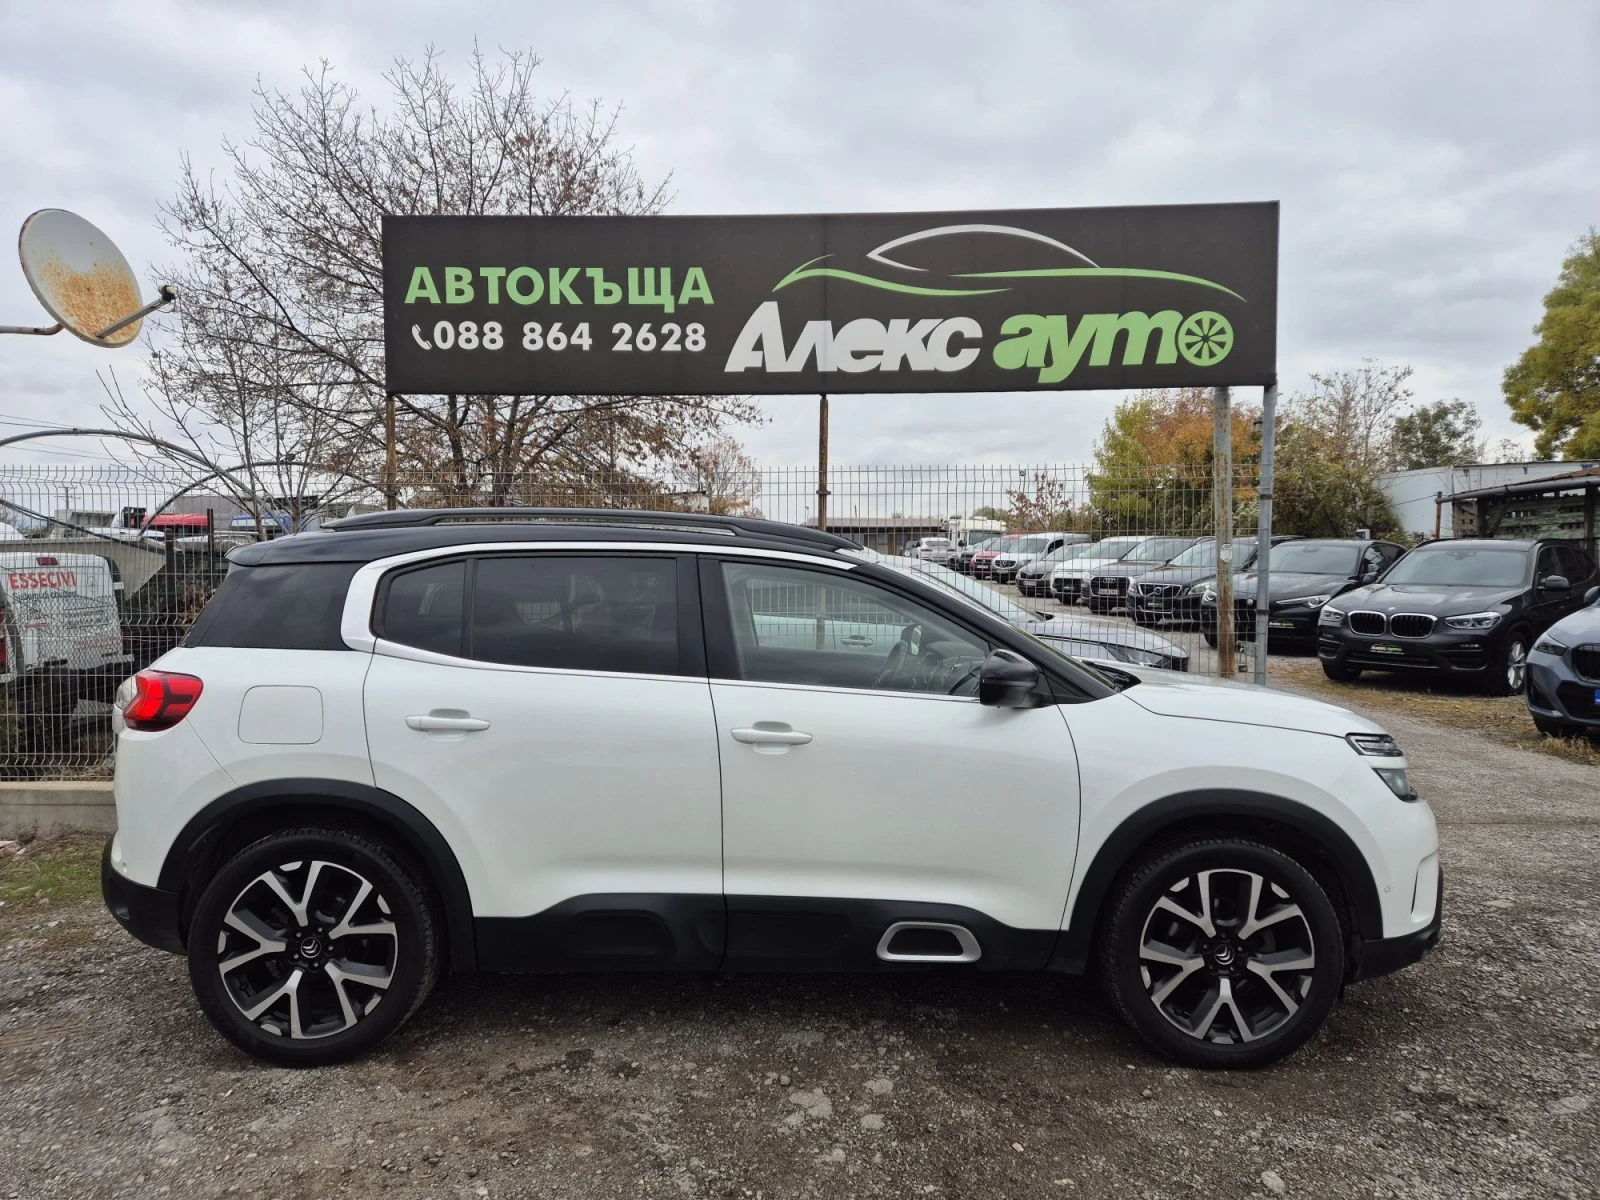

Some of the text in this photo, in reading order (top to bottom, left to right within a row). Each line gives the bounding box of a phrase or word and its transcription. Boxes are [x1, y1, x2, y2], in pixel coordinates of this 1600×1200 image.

[405, 266, 714, 314] АВТОКЪЩА
[434, 321, 707, 352] 088 864 2628
[9, 571, 77, 589] ESSECIVI
